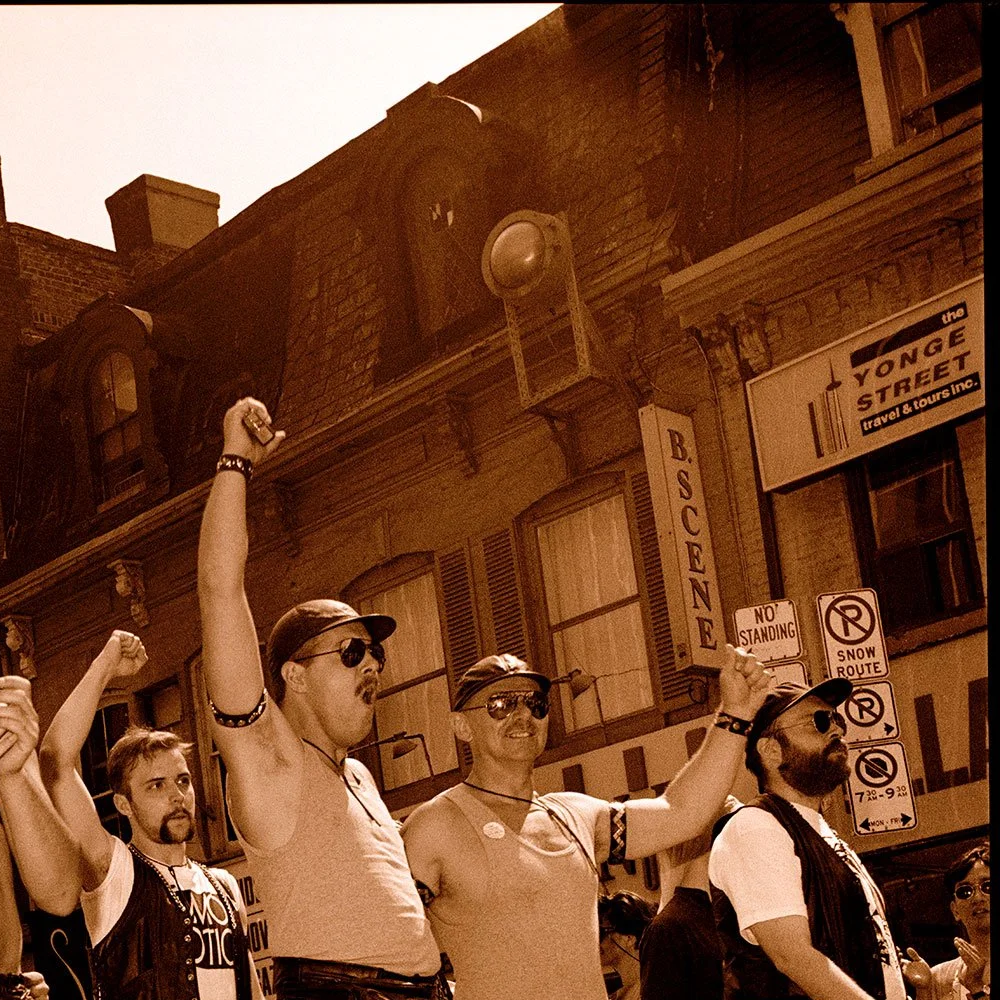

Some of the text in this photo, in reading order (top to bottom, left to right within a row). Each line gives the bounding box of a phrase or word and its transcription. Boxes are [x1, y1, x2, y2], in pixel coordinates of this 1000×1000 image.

[941, 306, 965, 324] the
[853, 326, 966, 387] YONGE
[857, 350, 971, 412] STREET
[862, 408, 901, 431] travel
[902, 403, 913, 415] &
[913, 388, 951, 410] tours
[754, 605, 775, 624] NO
[739, 621, 796, 647] STANDING
[836, 646, 876, 662] SNOW
[836, 662, 882, 678] ROUTE
